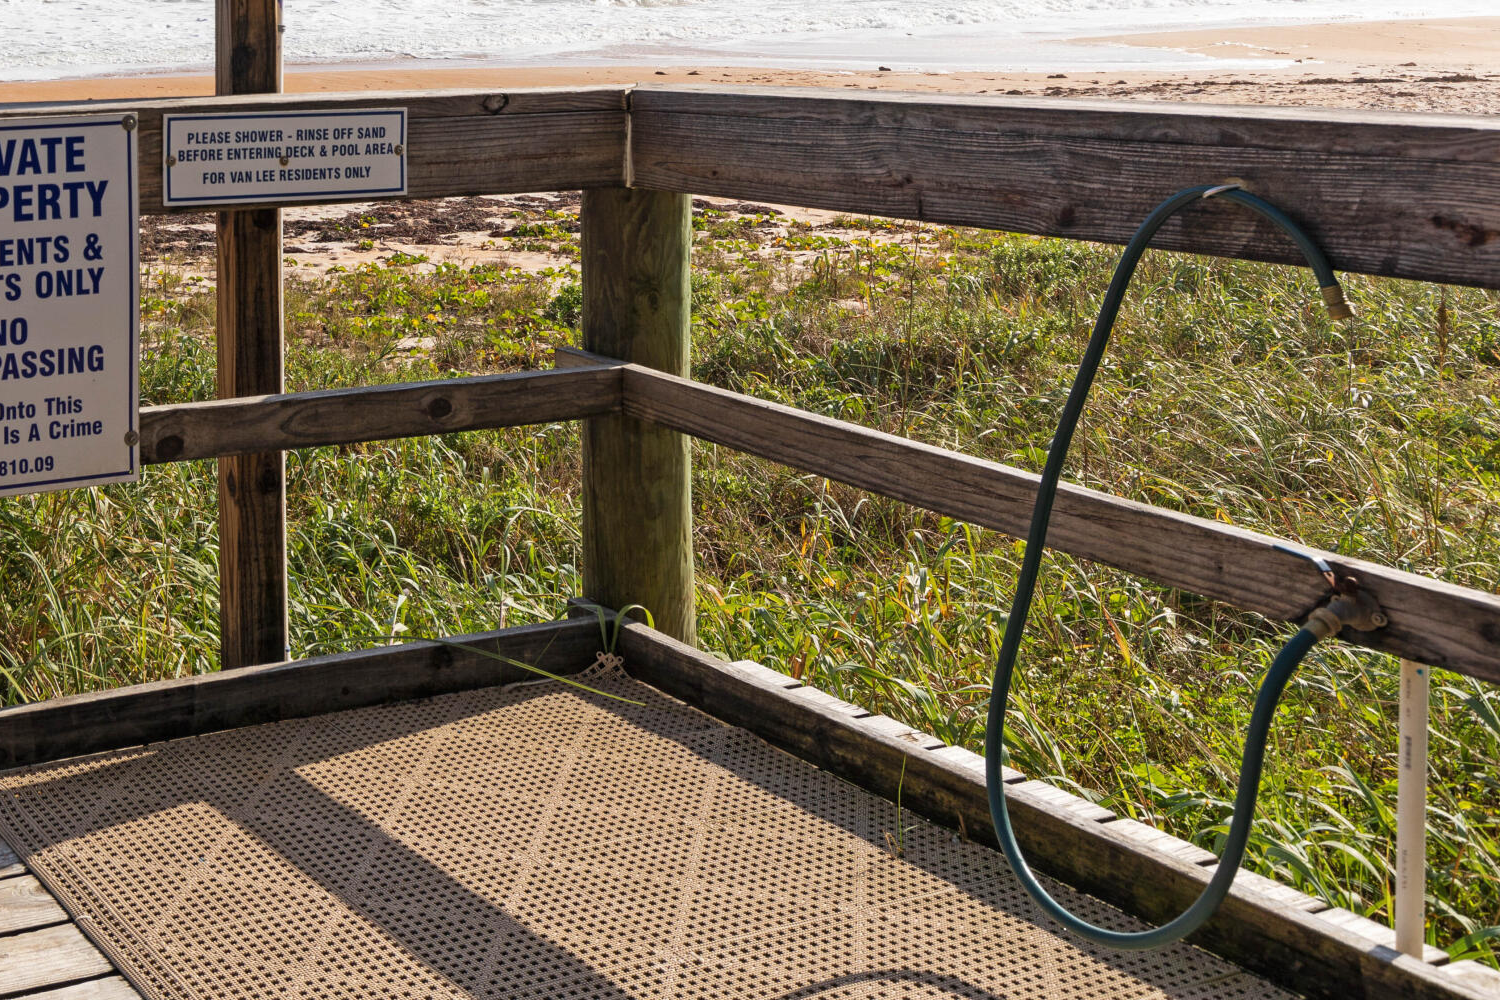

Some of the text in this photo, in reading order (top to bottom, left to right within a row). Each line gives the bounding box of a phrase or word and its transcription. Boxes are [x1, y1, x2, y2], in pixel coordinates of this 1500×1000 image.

[187, 131, 231, 145] PLEASE
[235, 130, 283, 143] SHOWER
[296, 128, 329, 141] RINSE
[333, 128, 354, 140] OFF
[357, 126, 386, 139] SAND
[178, 142, 394, 162] BEFORE ENTERING DECK & POOL AREA
[202, 166, 371, 185] FOR VAN LEE RESIDENTS ONLY
[83, 233, 103, 261] &
[35, 267, 105, 299] ONLY
[44, 395, 83, 416] This
[3, 426, 20, 445] Is
[28, 423, 41, 442] A
[49, 419, 103, 440] Crime
